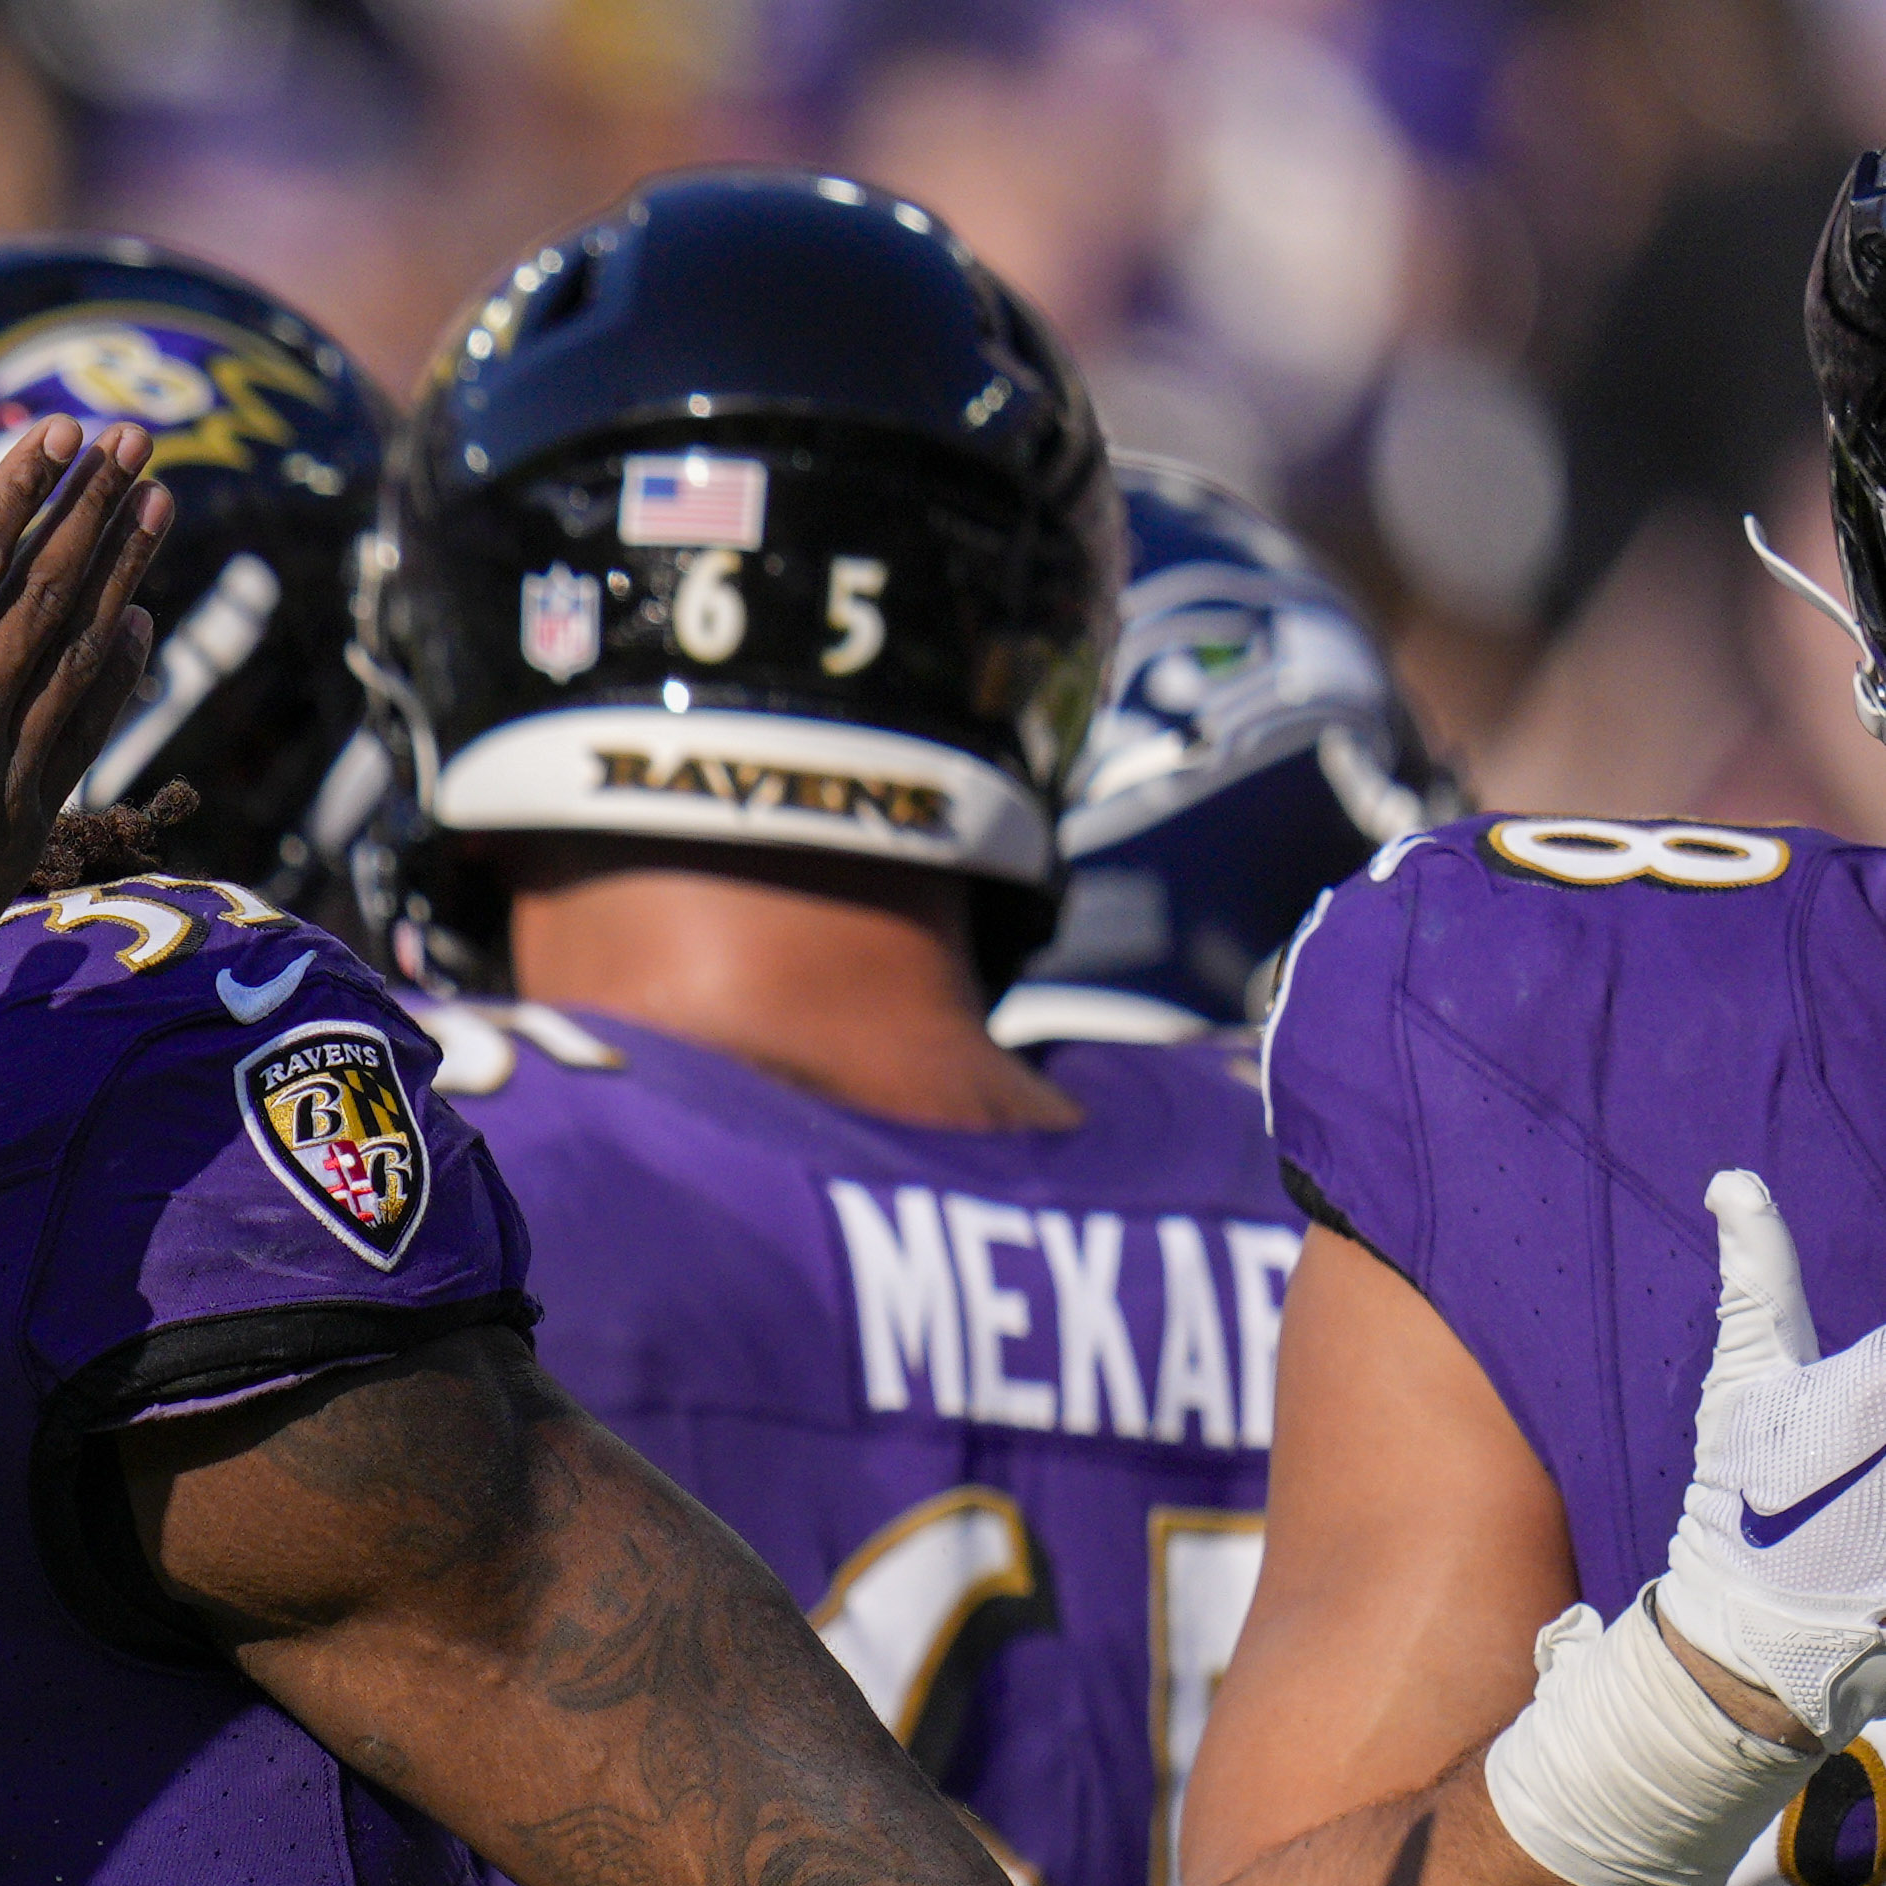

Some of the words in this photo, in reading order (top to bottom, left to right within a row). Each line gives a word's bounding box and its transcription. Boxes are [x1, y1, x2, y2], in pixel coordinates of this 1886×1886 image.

[589, 750, 960, 838] RAVENS
[258, 1043, 382, 1092] RAVENS
[270, 1076, 346, 1148] B
